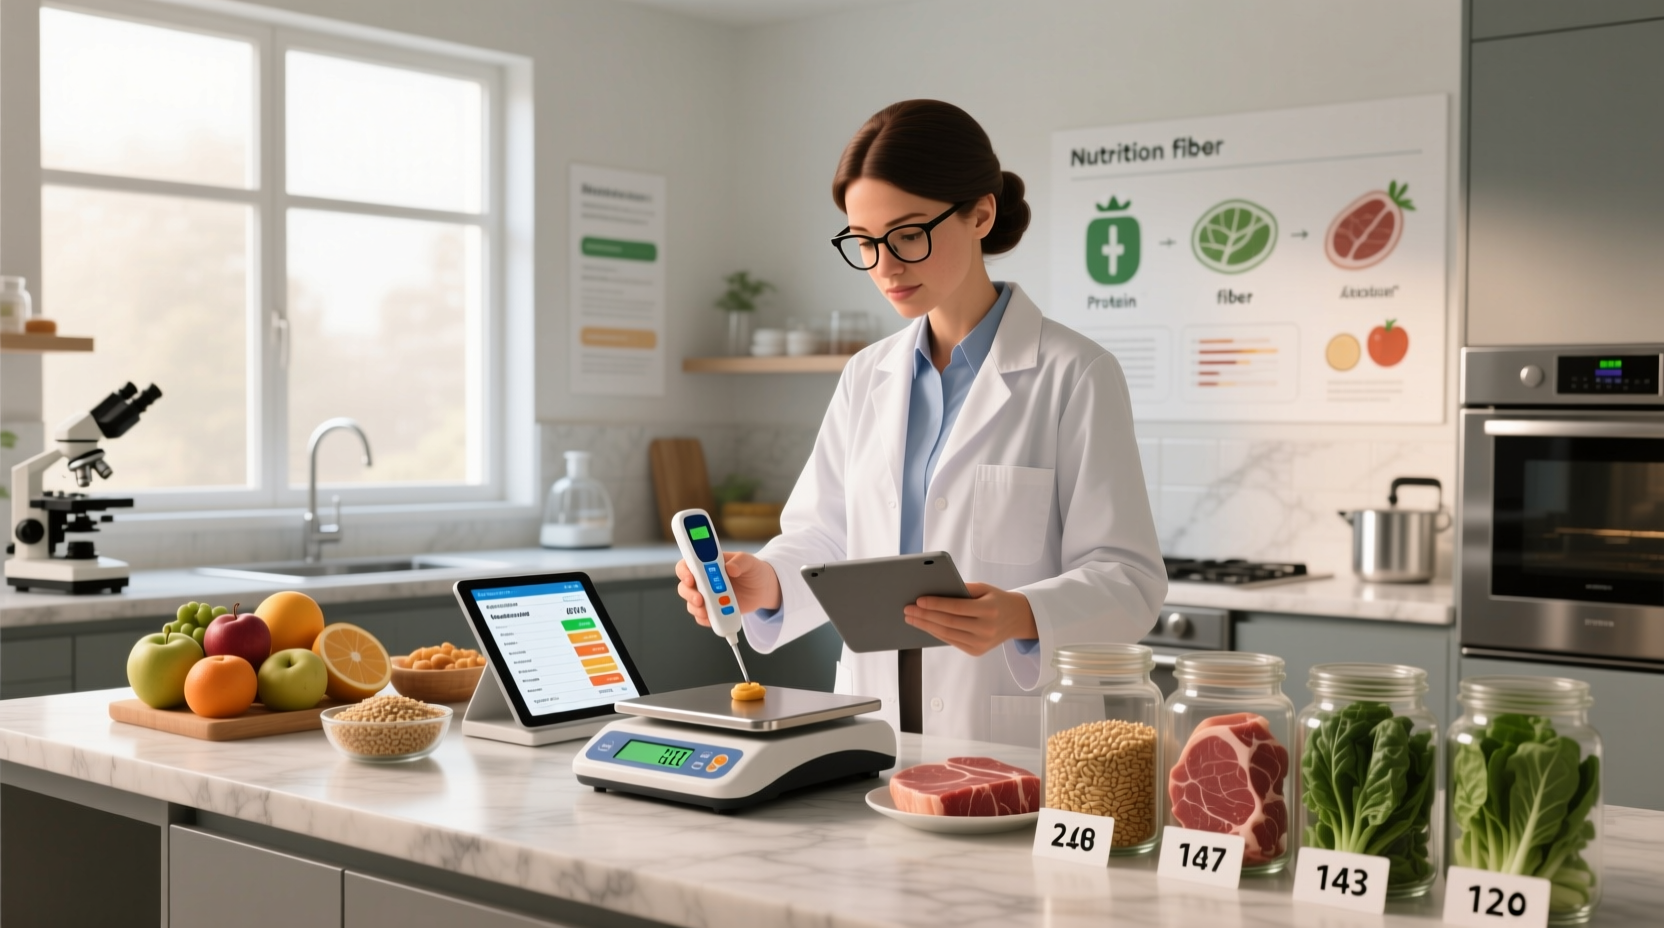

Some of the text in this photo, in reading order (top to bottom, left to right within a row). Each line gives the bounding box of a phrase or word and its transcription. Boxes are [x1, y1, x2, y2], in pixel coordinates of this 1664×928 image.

[1070, 136, 1225, 167] Nutrition fiber
[1087, 293, 1137, 309] Protein
[1216, 289, 1253, 304] fiber
[1179, 843, 1227, 872] 147
[1317, 865, 1368, 896] 143
[1469, 885, 1527, 917] 120
